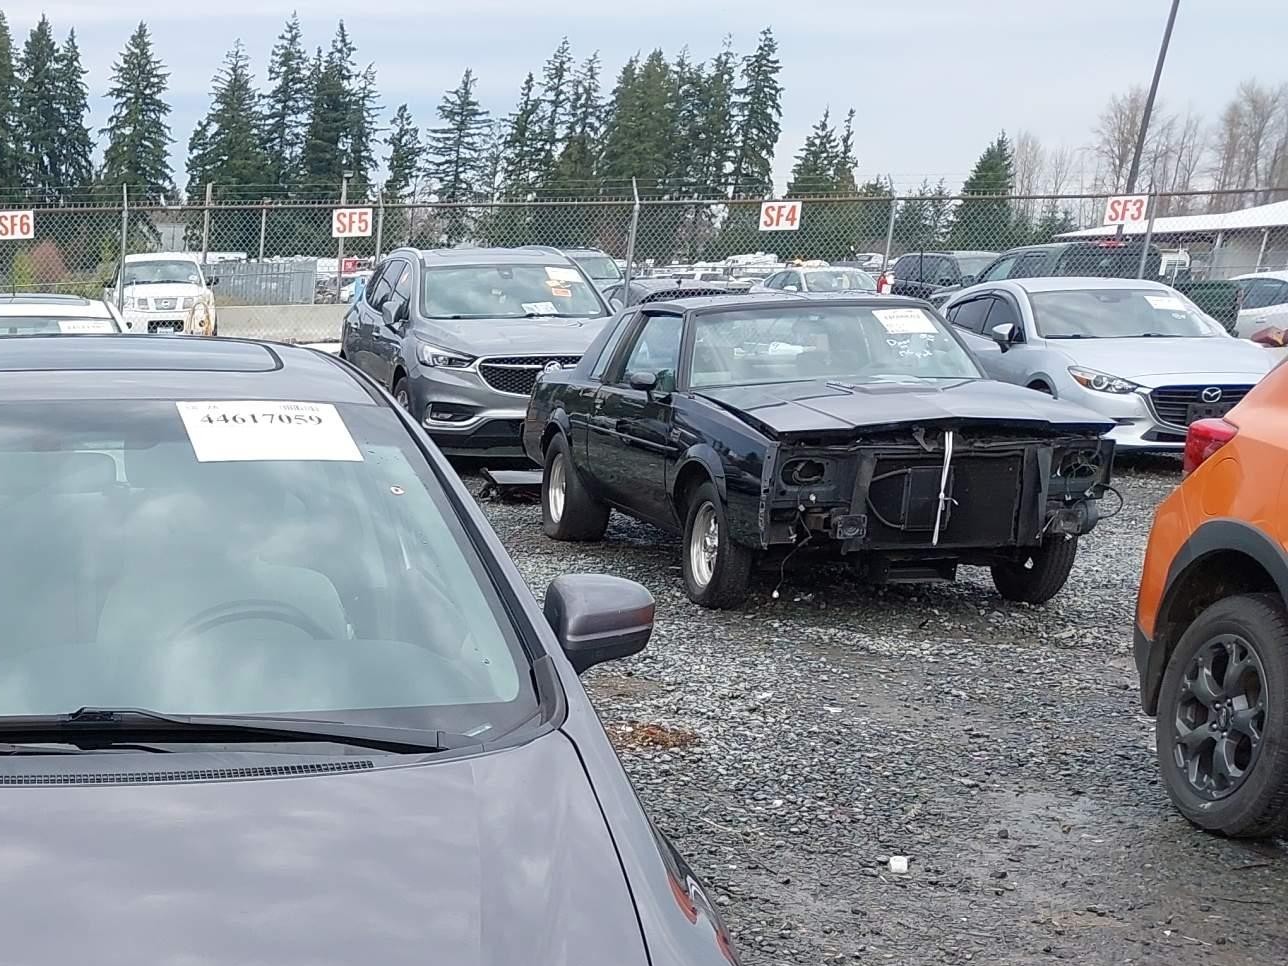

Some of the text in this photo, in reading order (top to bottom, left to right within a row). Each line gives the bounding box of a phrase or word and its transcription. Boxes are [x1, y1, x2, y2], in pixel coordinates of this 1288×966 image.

[763, 205, 797, 228] SF4
[1108, 199, 1145, 222] SF3
[336, 211, 369, 234] SF5
[200, 413, 322, 425] 44617059
